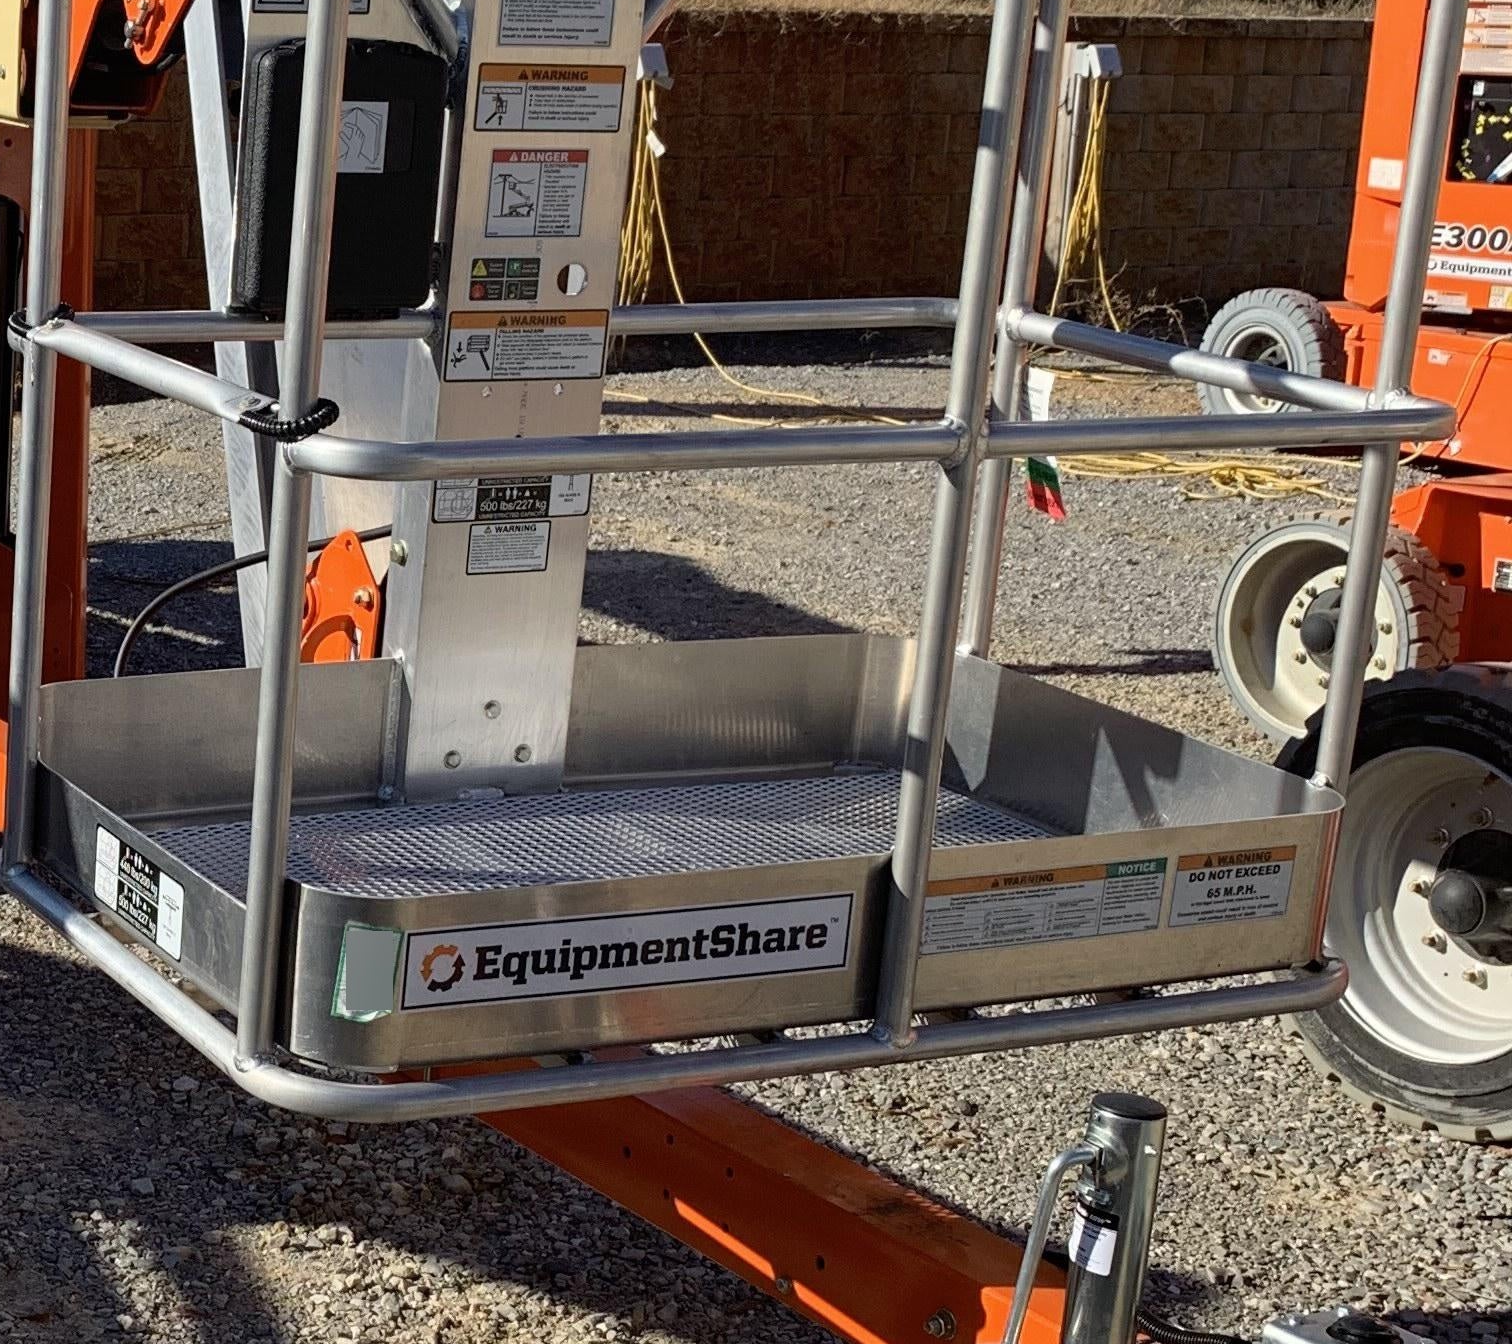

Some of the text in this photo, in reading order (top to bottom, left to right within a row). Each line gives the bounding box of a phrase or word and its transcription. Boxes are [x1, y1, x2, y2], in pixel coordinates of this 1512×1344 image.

[531, 69, 589, 81] WARNING
[521, 152, 569, 162] DANGER
[1431, 224, 1512, 252] E300
[510, 316, 568, 326] WARNING
[479, 501, 498, 512] 500
[500, 499, 533, 511] lbs/227
[535, 499, 547, 511] kg
[494, 524, 537, 534] WARNING
[1218, 851, 1272, 866] WARNING
[1118, 862, 1157, 875] NOTICE
[1189, 865, 1281, 883] DO NOT EXCEED
[1003, 873, 1054, 887] WARNING
[1207, 885, 1257, 899] 65 M.P.H.
[473, 921, 829, 985] EquipmentShare
